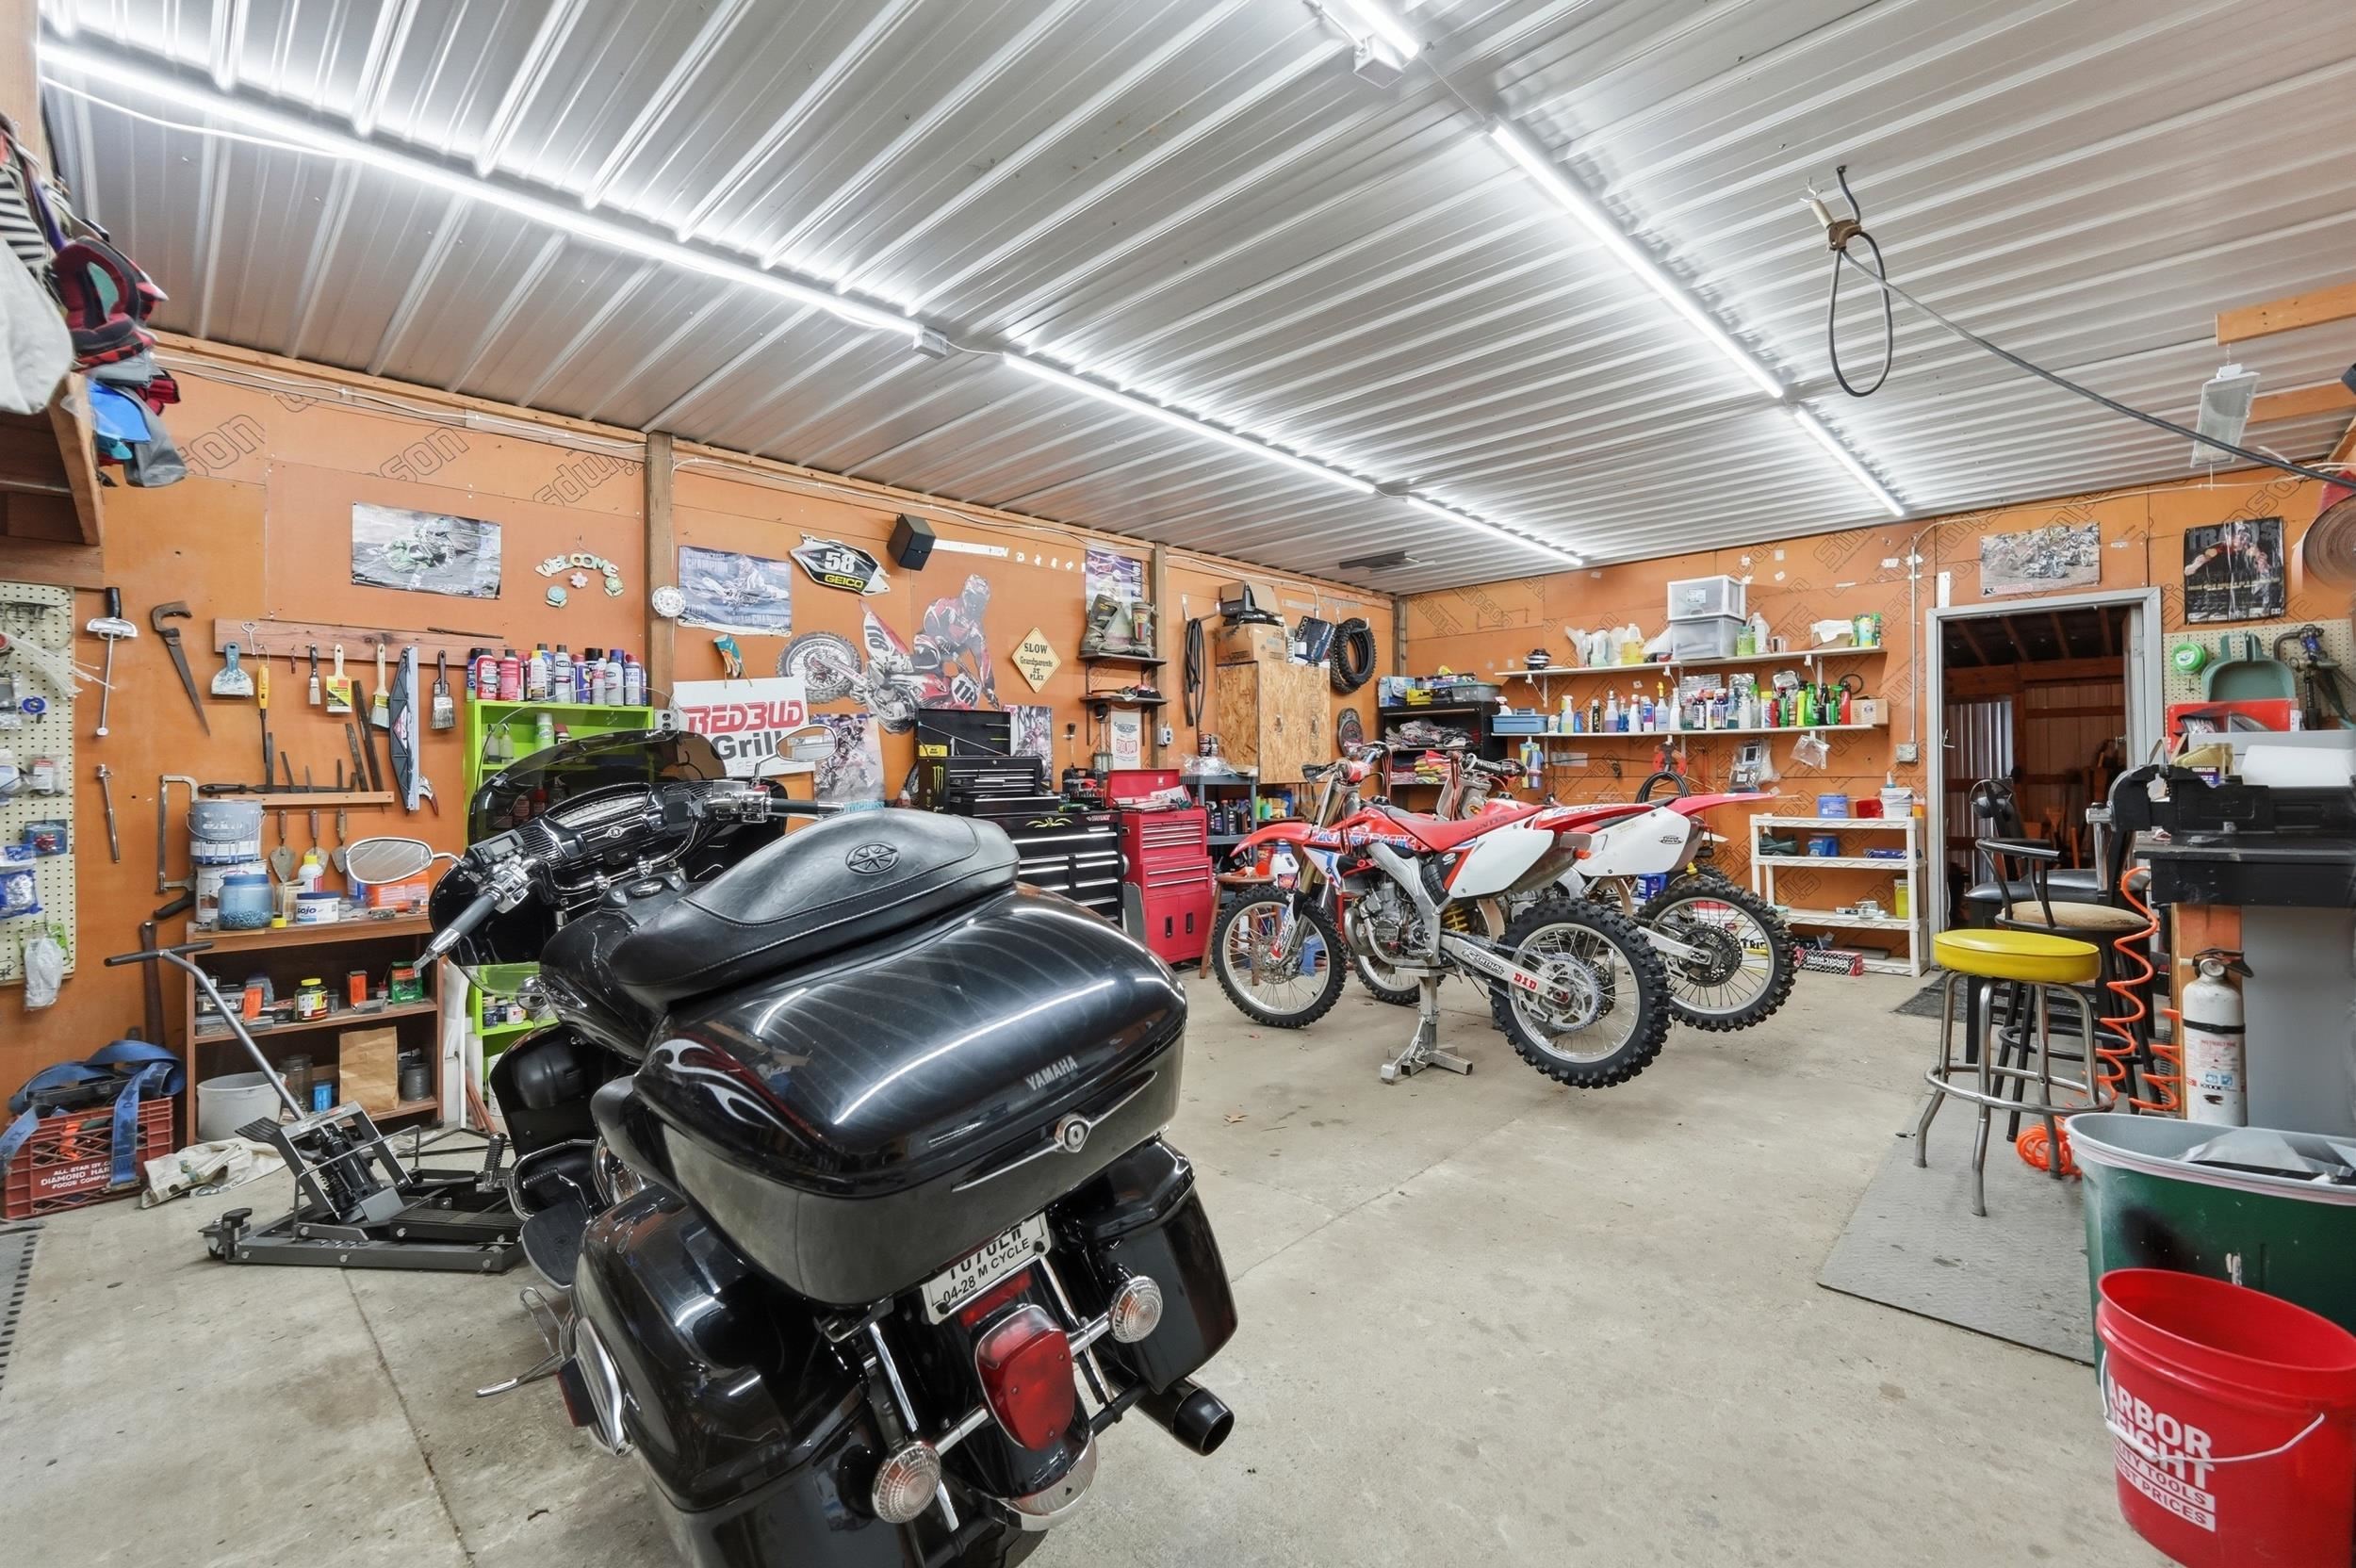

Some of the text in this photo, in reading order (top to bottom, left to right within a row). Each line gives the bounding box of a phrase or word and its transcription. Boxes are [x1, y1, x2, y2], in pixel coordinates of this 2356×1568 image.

[535, 553, 619, 578] WELCOME
[824, 551, 855, 574] 58
[824, 574, 863, 588] GEICO
[1023, 643, 1048, 655] SLOW
[680, 700, 804, 734] REDBUD
[1025, 1055, 1078, 1090] YAMAHA
[41, 1171, 86, 1186] DIAMOND
[71, 1165, 90, 1173] STAR
[943, 1275, 976, 1302] 04-28
[977, 1265, 989, 1278] M
[990, 1237, 1030, 1269] CYCLE
[2107, 1375, 2215, 1472] ARBOR
[2147, 1463, 2206, 1506] TOOLS
[2141, 1480, 2207, 1526] PRICES
